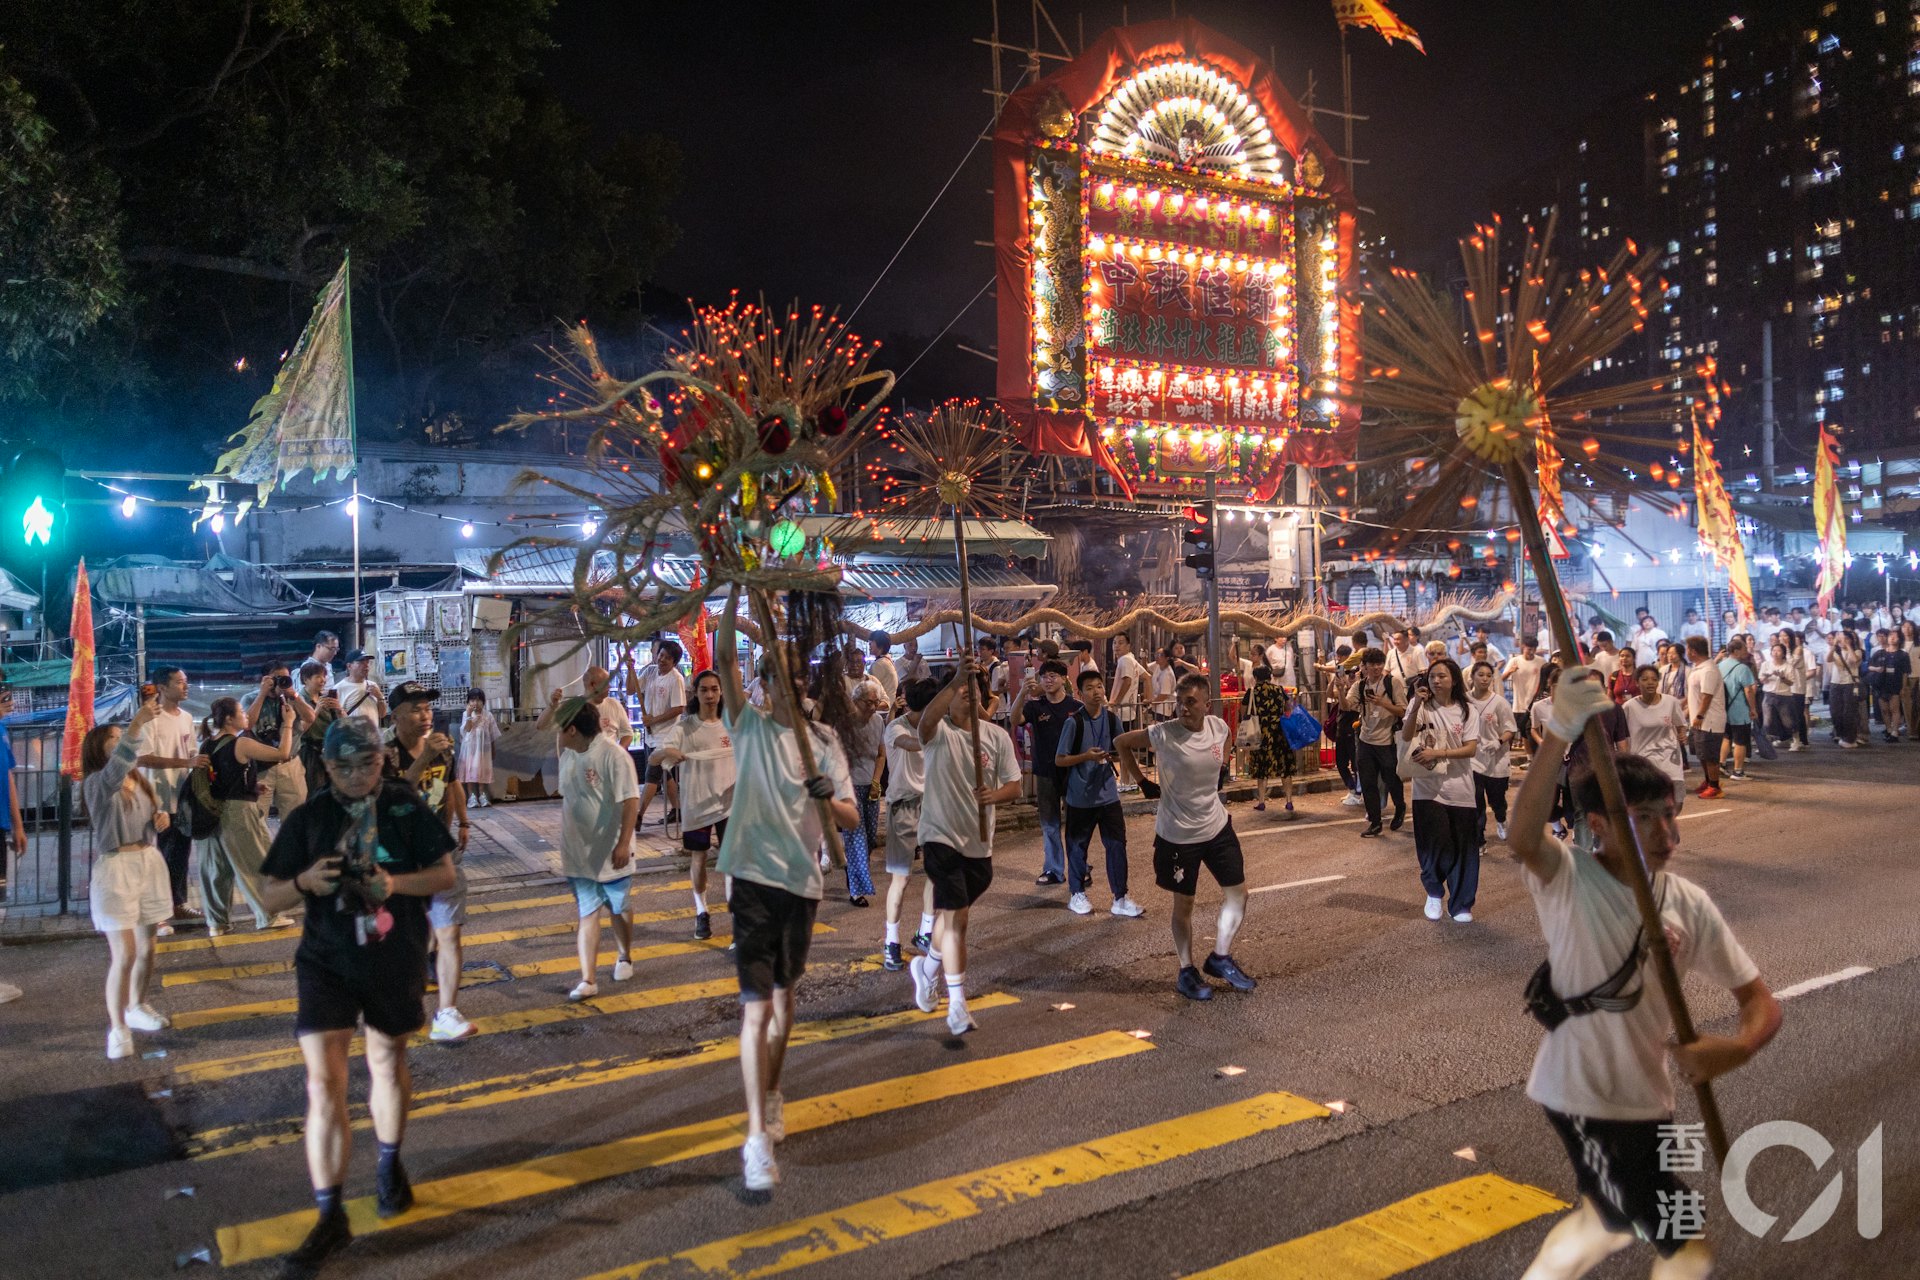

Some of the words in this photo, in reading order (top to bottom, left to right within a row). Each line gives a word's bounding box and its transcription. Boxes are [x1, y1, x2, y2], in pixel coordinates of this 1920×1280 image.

[1100, 253, 1278, 326] 中秋佳節
[1098, 308, 1284, 368] 薄扶林村火龍盛會
[1105, 394, 1154, 418] 婦女會
[1176, 402, 1215, 421] 咖啡
[1170, 437, 1223, 470] 敬賀
